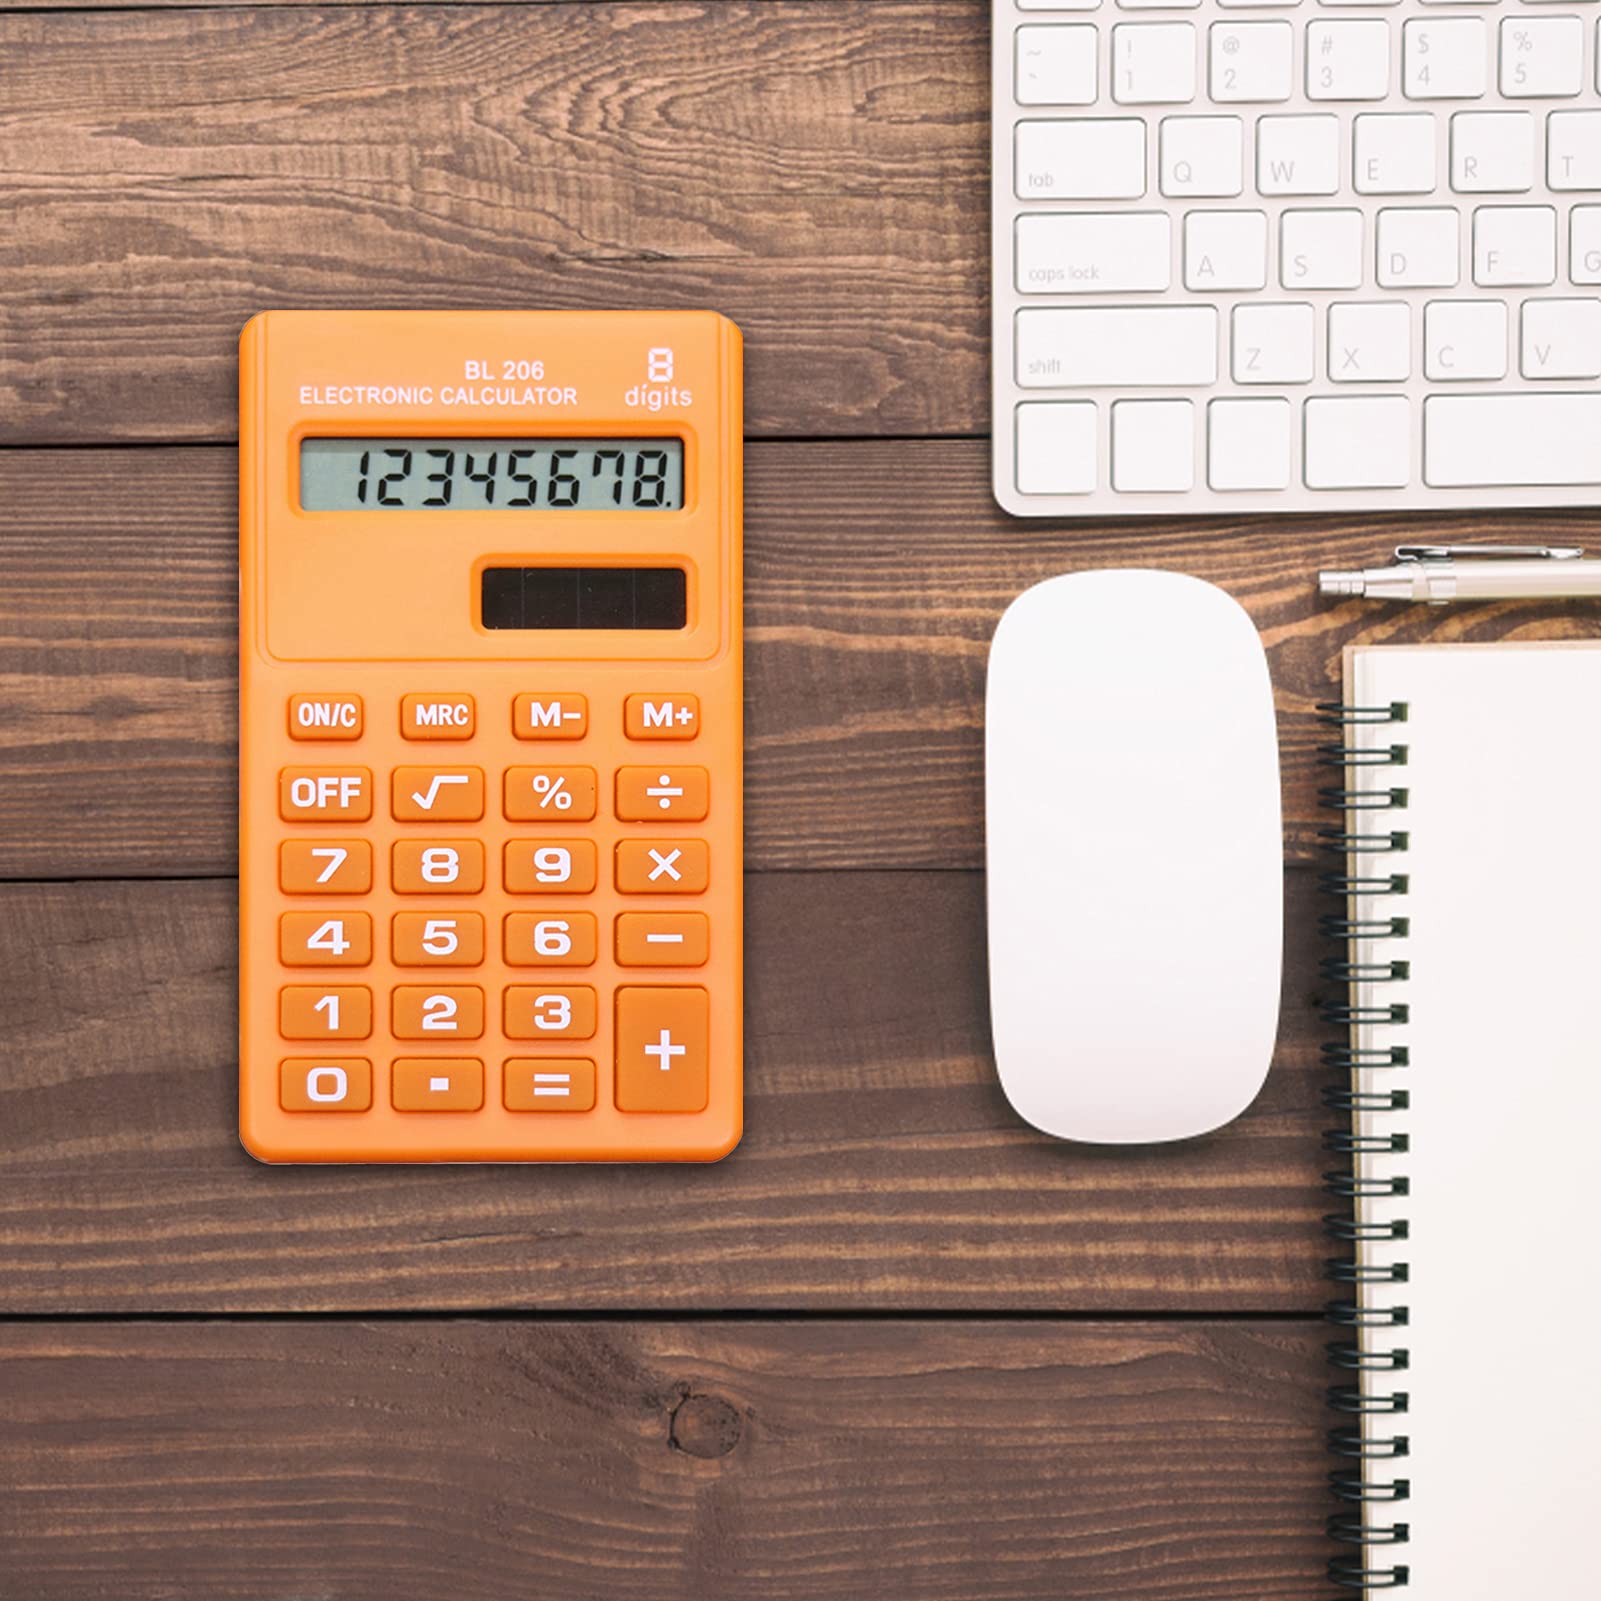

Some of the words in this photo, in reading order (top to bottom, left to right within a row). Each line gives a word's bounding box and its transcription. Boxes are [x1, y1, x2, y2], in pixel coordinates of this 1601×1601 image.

[1222, 35, 1240, 55] @
[1321, 35, 1333, 55] #
[1417, 33, 1430, 55] $
[1513, 31, 1533, 52] %
[1224, 68, 1237, 89] 2
[1320, 65, 1333, 89] 3
[1417, 63, 1431, 86] 4
[1514, 62, 1527, 85] 5
[1173, 160, 1193, 184] Q
[1270, 160, 1295, 183] W
[1367, 157, 1379, 181] E
[1463, 155, 1478, 179] R
[1561, 155, 1575, 178] T
[1028, 172, 1054, 188] tab
[1196, 255, 1215, 277] A
[1293, 254, 1309, 278] S
[1390, 252, 1407, 276] D
[1487, 250, 1499, 273] F
[1583, 250, 1601, 273] G
[1028, 269, 1065, 284] caps
[1067, 265, 1099, 280] lock
[648, 348, 673, 382] 8
[1028, 358, 1061, 374] shift
[1246, 347, 1261, 371] Z
[1342, 347, 1360, 369] X
[1437, 345, 1455, 369] C
[1534, 343, 1552, 366] V
[465, 360, 495, 380] BL
[503, 360, 544, 380] 206
[300, 386, 433, 404] ELECTRONIC
[440, 386, 577, 405] CALCULATOR
[299, 703, 355, 727] ON/C
[416, 704, 467, 725] MRC
[644, 702, 693, 726] M+
[292, 778, 361, 807] OFF
[533, 776, 571, 809] %
[312, 849, 347, 882] 7
[422, 848, 458, 882] 8
[534, 848, 570, 882] 9
[308, 921, 349, 954] 4
[423, 921, 457, 955] 5
[535, 921, 571, 955] 6
[315, 996, 338, 1029] 1
[423, 995, 456, 1029] 2
[535, 996, 570, 1029] 3
[645, 1030, 685, 1070] +
[307, 1068, 347, 1101] 0
